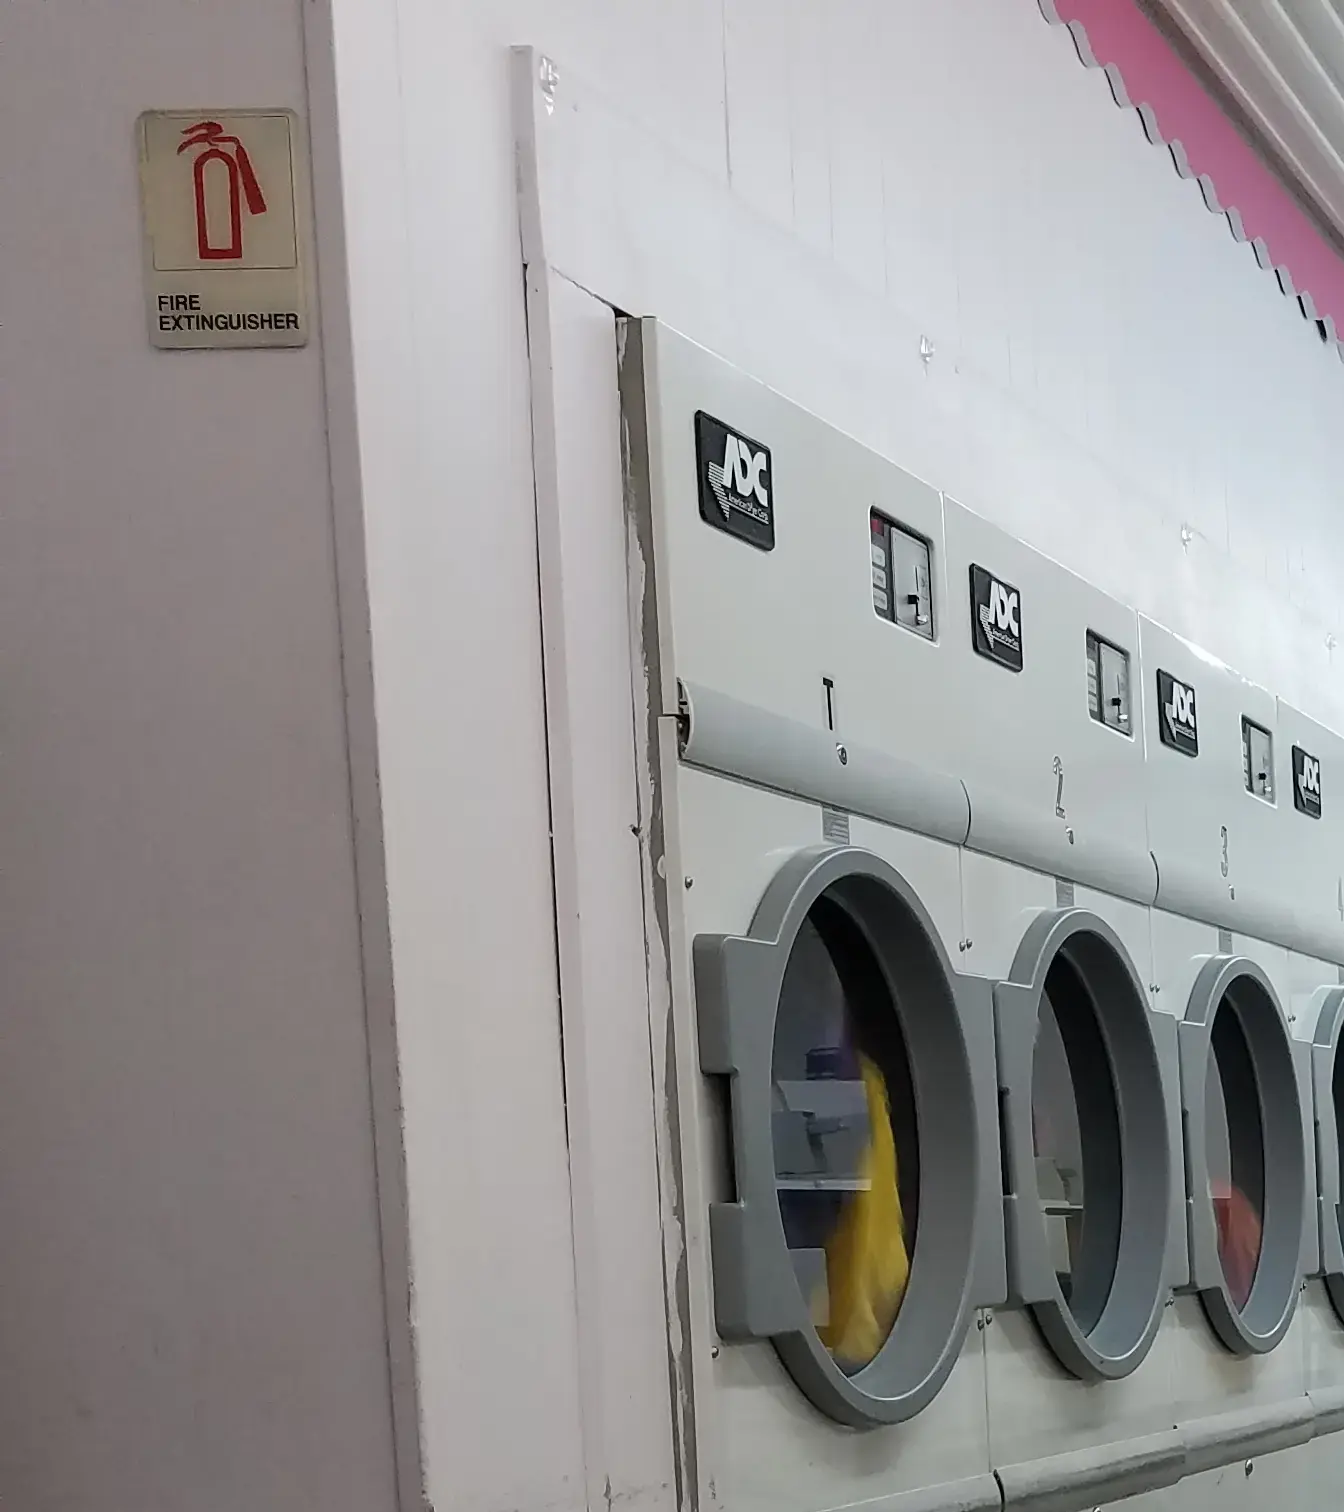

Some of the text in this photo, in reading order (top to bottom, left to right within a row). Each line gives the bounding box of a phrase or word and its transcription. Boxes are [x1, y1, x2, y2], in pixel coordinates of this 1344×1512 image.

[157, 294, 201, 311] FIRE
[159, 313, 300, 331] EXTINGUISHER
[723, 433, 768, 508] ADC
[989, 580, 1019, 638] ADC
[1053, 756, 1066, 820] 2
[1221, 825, 1228, 878] 3
